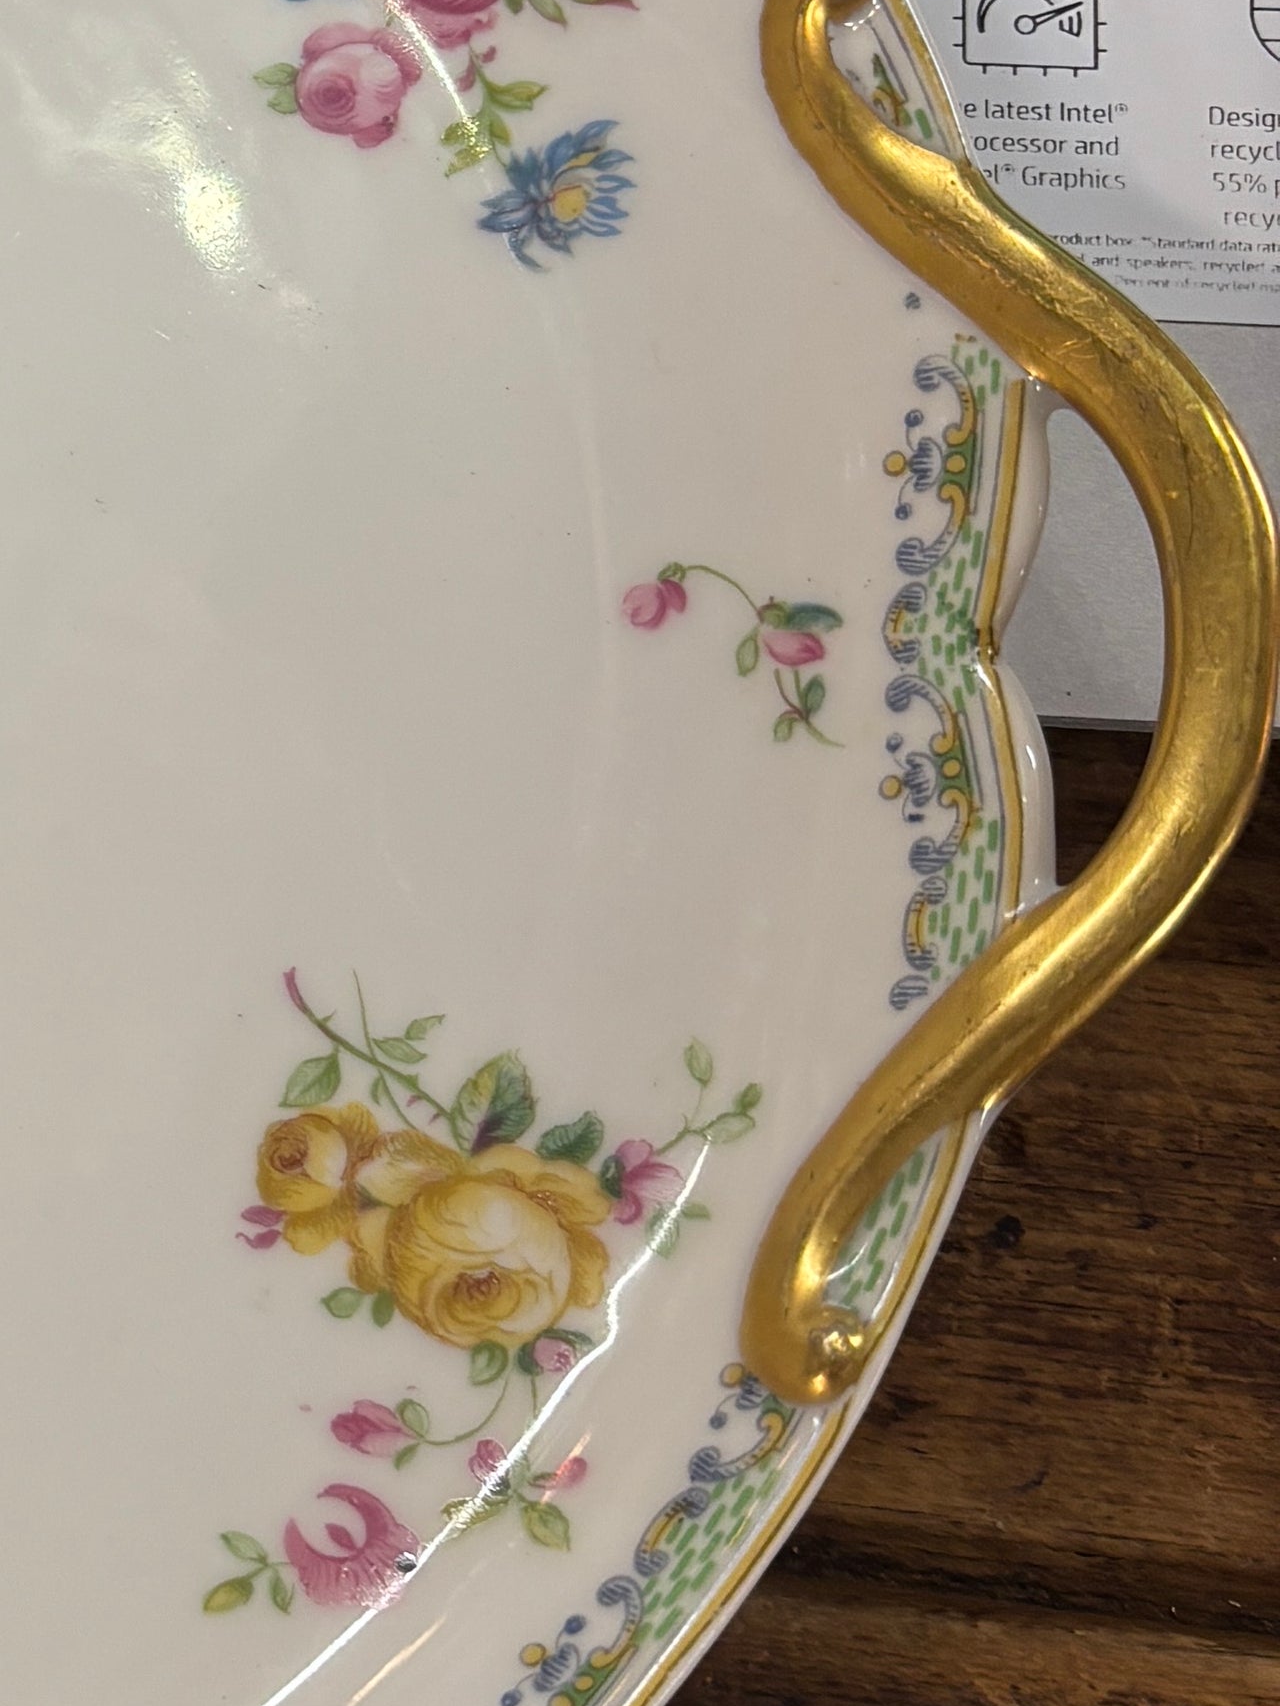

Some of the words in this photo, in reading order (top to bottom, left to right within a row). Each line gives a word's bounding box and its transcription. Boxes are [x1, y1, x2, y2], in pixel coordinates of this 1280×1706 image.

[984, 98, 1052, 122] latest
[1208, 105, 1280, 133] Desig
[971, 134, 1069, 155] ocessor
[1074, 135, 1120, 157] and
[1021, 165, 1127, 192] Graphics
[1212, 171, 1268, 194] 55%
[1223, 210, 1280, 232] recy
